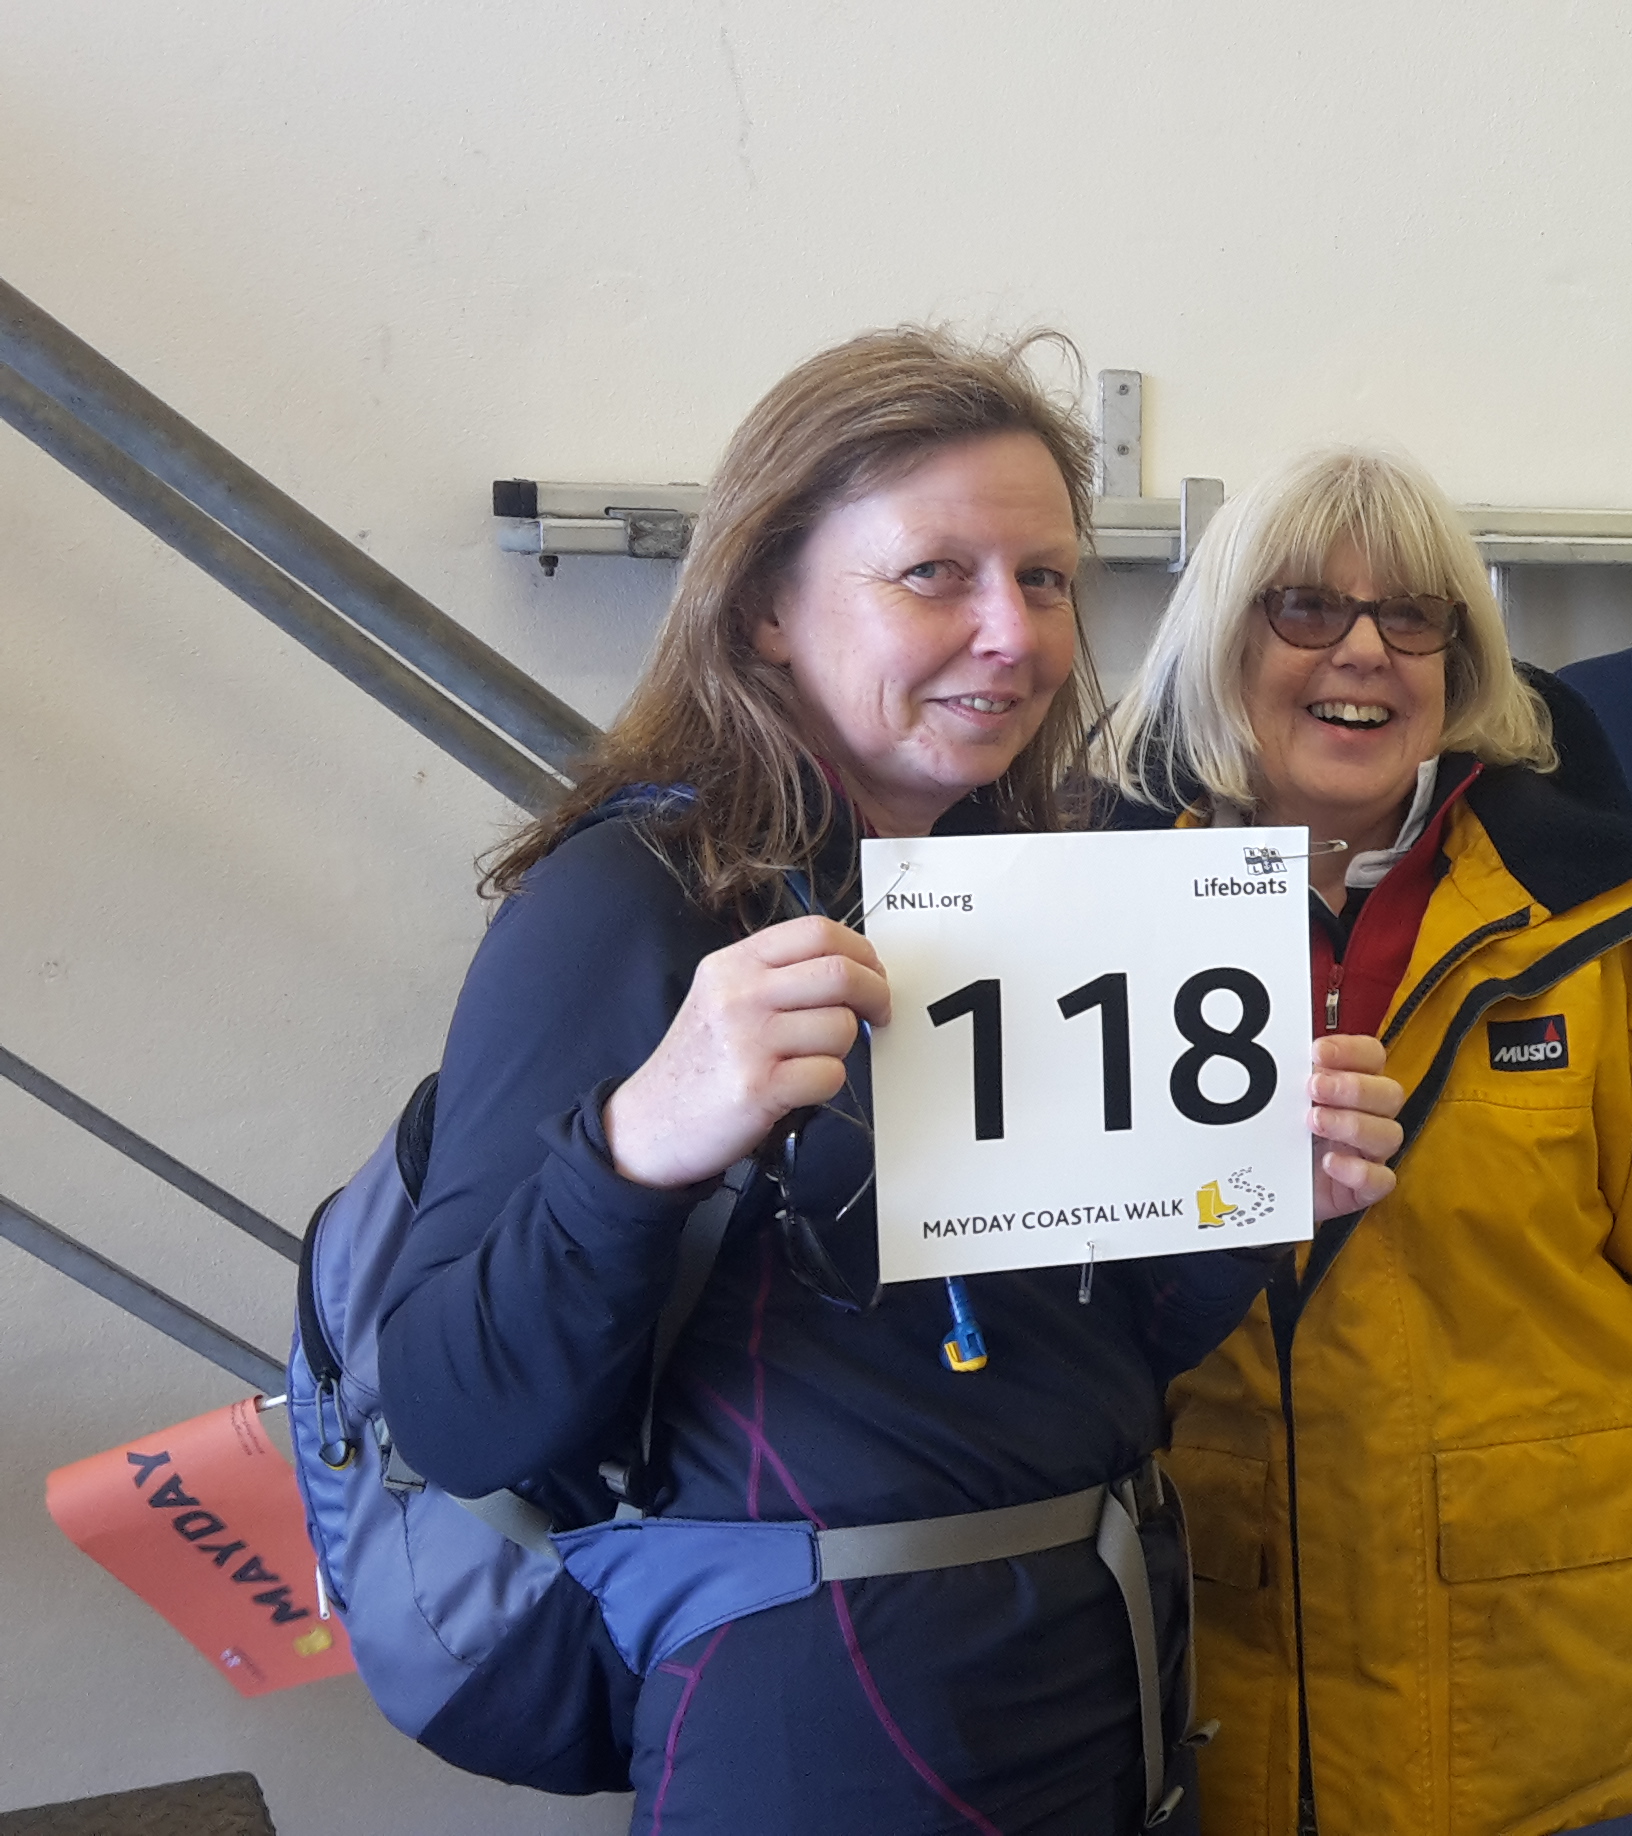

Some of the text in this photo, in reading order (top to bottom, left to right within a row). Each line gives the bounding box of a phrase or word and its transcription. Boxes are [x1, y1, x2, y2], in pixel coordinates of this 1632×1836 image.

[886, 892, 974, 912] RNLI.org
[1194, 876, 1287, 897] Lifeboats
[926, 966, 1278, 1142] 118
[1494, 1041, 1563, 1063] MUSTO
[923, 1198, 1184, 1239] MAYDAY COASTAL WALK
[126, 1450, 310, 1626] MAYDAY
